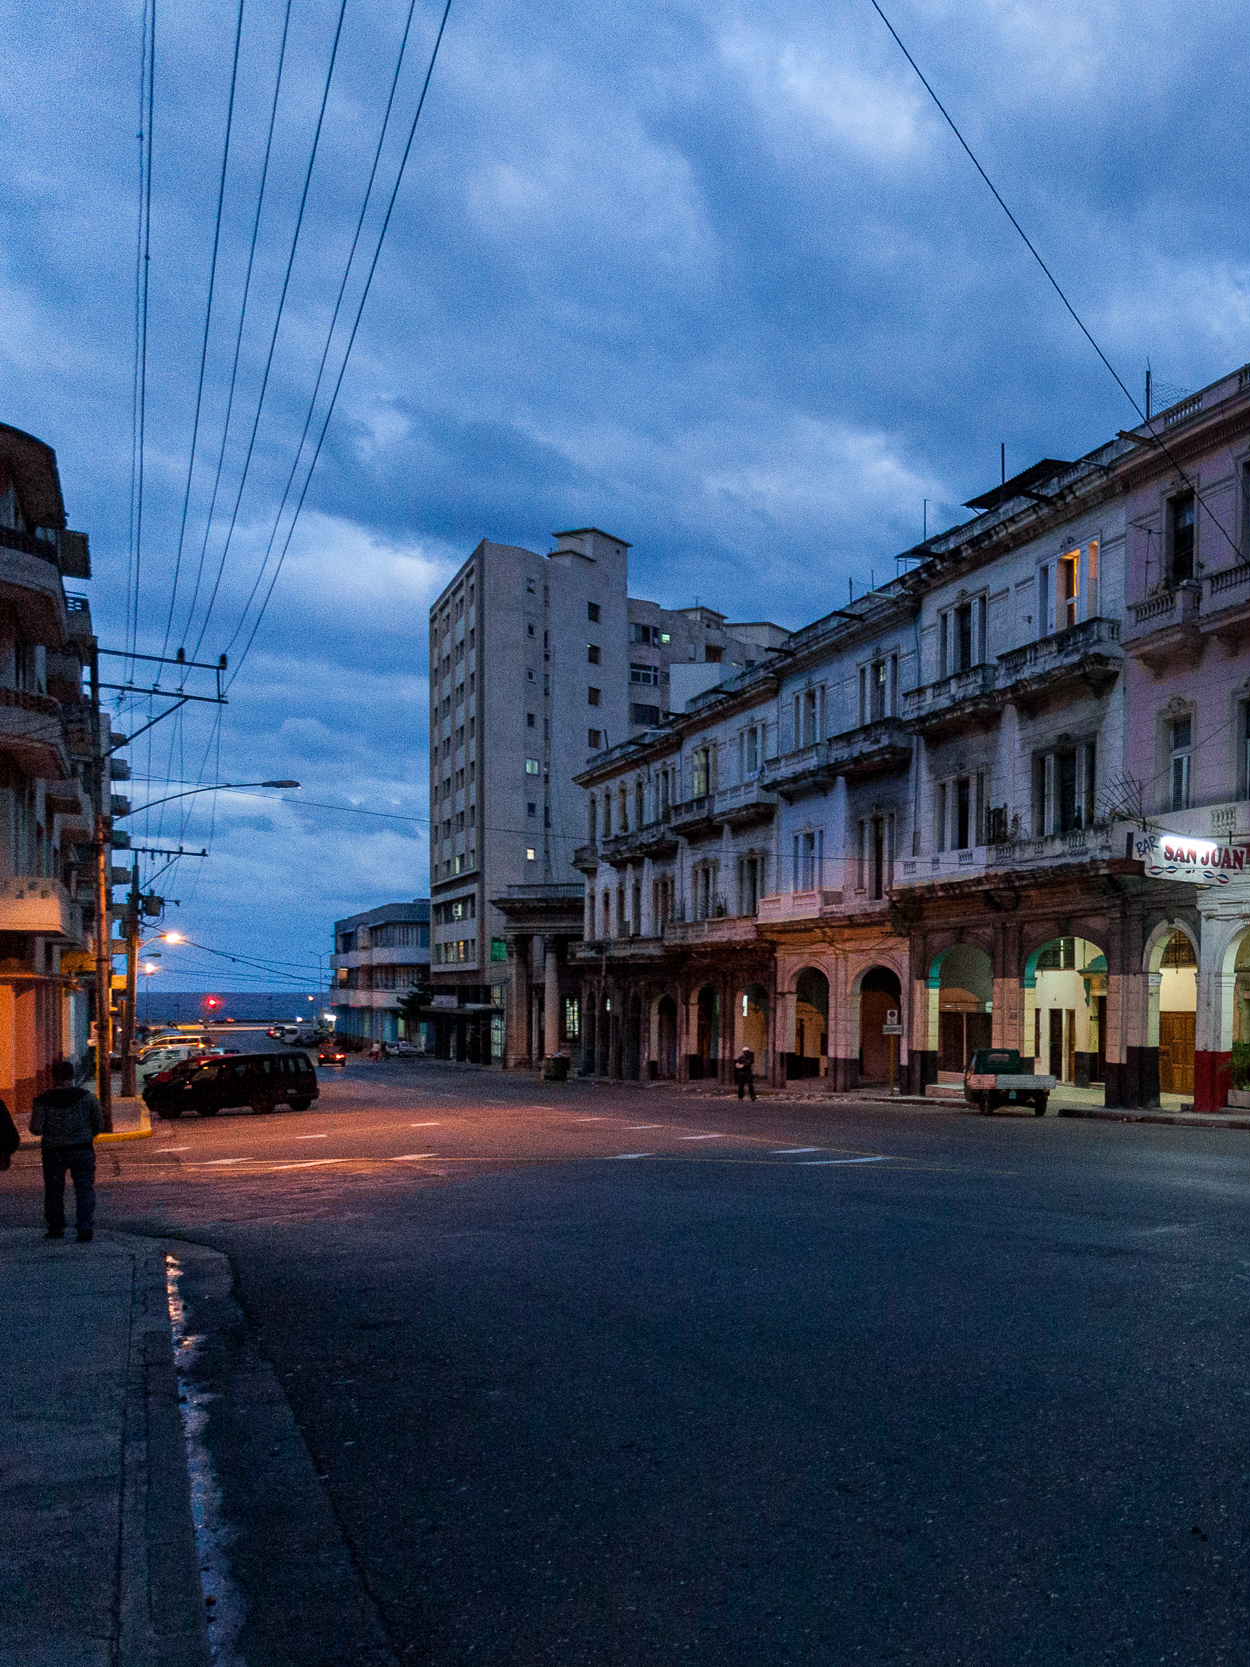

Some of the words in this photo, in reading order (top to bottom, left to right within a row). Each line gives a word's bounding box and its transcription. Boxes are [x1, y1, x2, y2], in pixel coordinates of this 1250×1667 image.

[1135, 835, 1159, 858] BAR
[1164, 843, 1197, 864] SAN
[1201, 847, 1245, 870] JUAN
